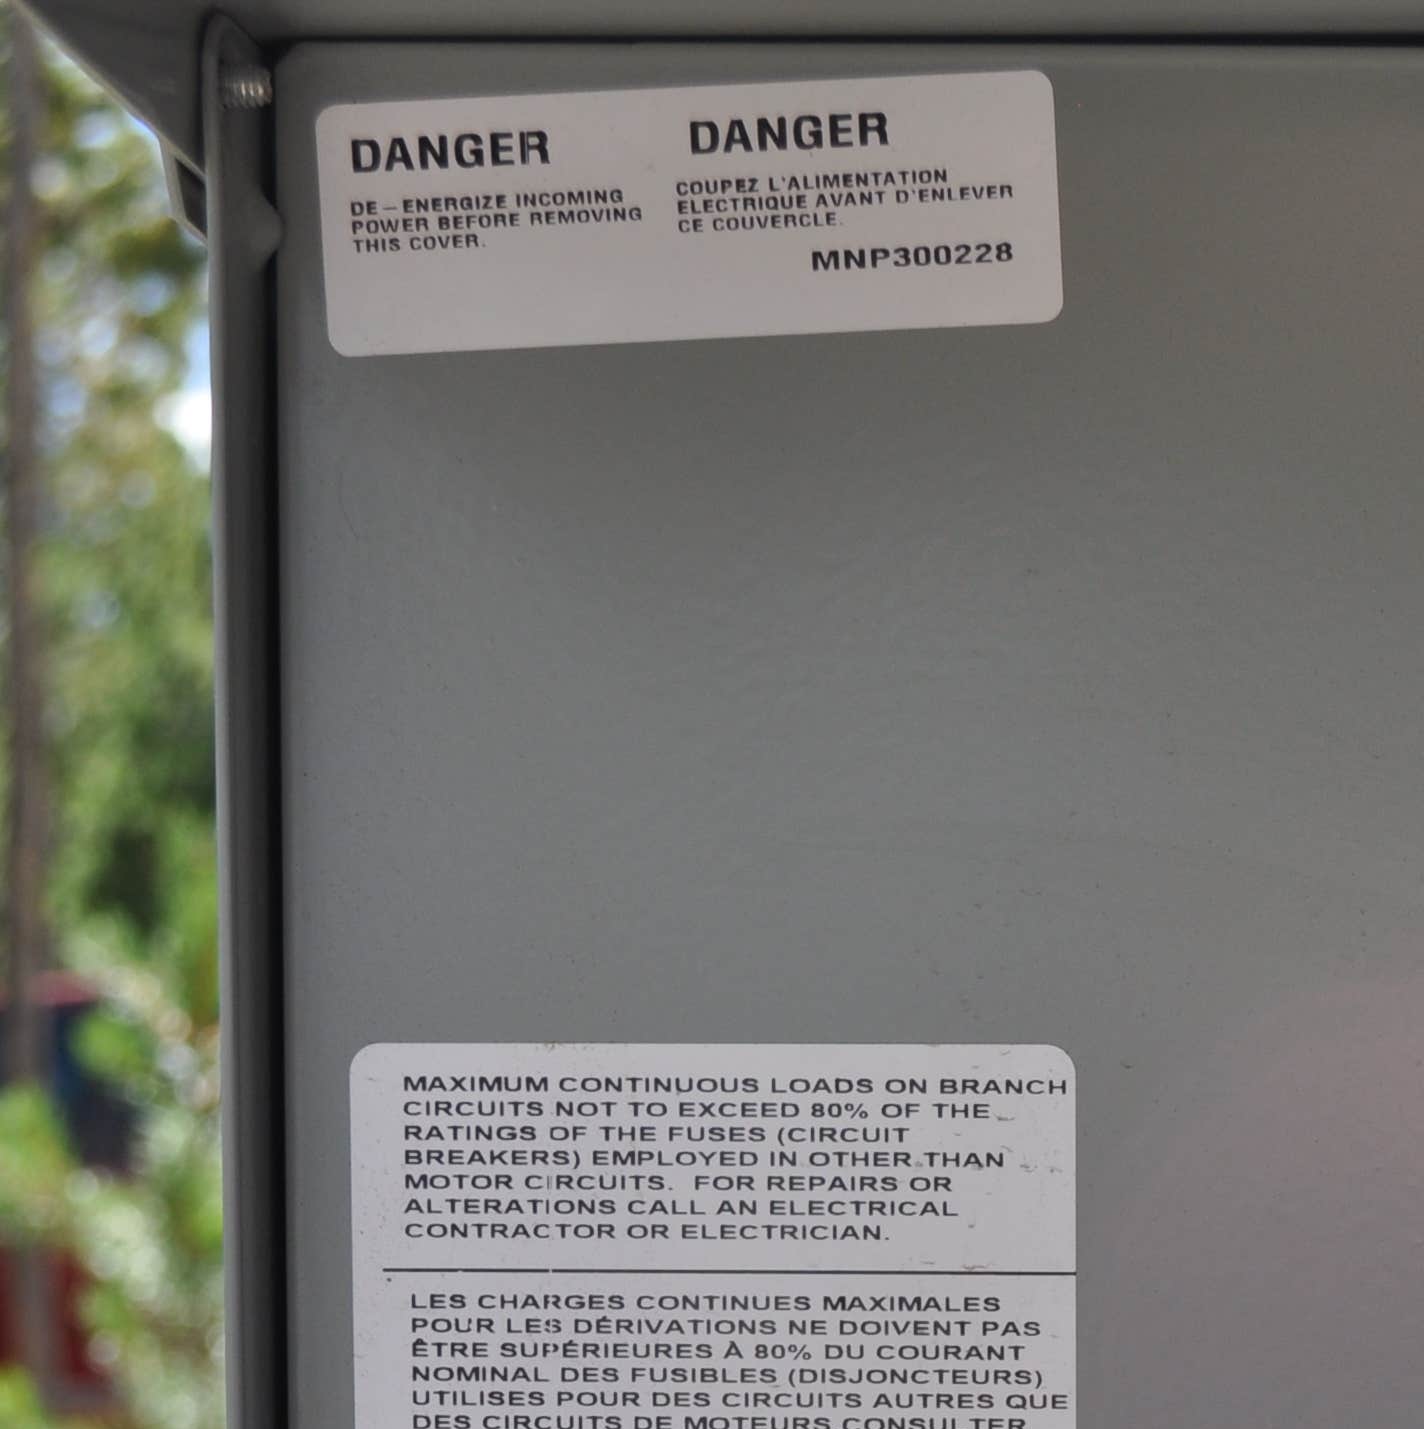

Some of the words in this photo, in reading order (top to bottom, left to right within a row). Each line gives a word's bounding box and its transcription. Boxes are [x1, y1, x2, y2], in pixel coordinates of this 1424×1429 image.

[689, 111, 889, 155] DANGER
[350, 130, 551, 174] DANGER
[675, 177, 759, 197] COUPEZ
[768, 168, 948, 193] L'ALIMENTATION
[676, 194, 807, 215] ELECTRIQUE
[815, 190, 886, 208] AVANT
[895, 184, 1013, 204] D'ENLEVER
[351, 216, 429, 236] POWER
[437, 212, 520, 231] BEFORE
[529, 206, 642, 226] REMOVING
[677, 218, 703, 233] CE
[712, 211, 844, 232] COUVERCLE.
[352, 237, 401, 254] THIS
[409, 233, 487, 251] COVER.
[811, 241, 1013, 272] MNP300228
[403, 1075, 549, 1093] MAXIMUM
[558, 1076, 759, 1094] CONTINUOUS
[771, 1077, 874, 1094] LOADS
[884, 1078, 927, 1095] ON
[939, 1078, 1067, 1095] BRANCH
[403, 1100, 544, 1117] CIRCUITS
[555, 1100, 618, 1118] NOT
[627, 1101, 668, 1118] TO
[678, 1101, 800, 1118] EXCEED
[810, 1102, 869, 1119] 80%
[880, 1102, 921, 1119] OF
[932, 1102, 990, 1119] THE
[404, 1124, 537, 1142] RATINGS
[549, 1125, 587, 1142] OF
[599, 1125, 657, 1142] THE
[668, 1126, 766, 1143] FUSES
[777, 1126, 910, 1147] (CIRCUIT
[404, 1149, 581, 1170] BREAKERS)
[592, 1149, 759, 1167] EMPLOYED
[769, 1150, 797, 1167] IN
[808, 1151, 912, 1168] OTHER
[923, 1151, 1004, 1169] THAN
[404, 1173, 514, 1190] MOTOR
[524, 1174, 673, 1191] CIRCUITS.
[694, 1175, 755, 1191] FOR
[766, 1175, 898, 1192] REPAIRS
[909, 1175, 953, 1192] OR
[403, 1198, 617, 1215] ALTERATIONS
[627, 1199, 706, 1216] CALL
[715, 1199, 757, 1216] AN
[769, 1199, 959, 1217] ELECTRICAL
[404, 1222, 616, 1239] CONTRACTOR
[626, 1223, 670, 1240] OR
[681, 1223, 890, 1241] ELECTRICIAN.
[411, 1293, 467, 1310] LES
[477, 1293, 625, 1310] CHARGES
[636, 1294, 812, 1311] CONTINUES
[823, 1295, 1001, 1313] MAXIMALES
[411, 1317, 495, 1334] POUR
[506, 1317, 562, 1334] LES
[573, 1315, 777, 1335] DÉRIVATIONS
[788, 1319, 828, 1336] NE
[839, 1319, 972, 1337] DOIVENT
[982, 1320, 1041, 1337] PAS
[411, 1337, 489, 1358] ÊTRE
[499, 1339, 713, 1359] SUPÉRIEURES
[723, 1340, 744, 1360] À
[754, 1343, 812, 1361] 80%
[824, 1343, 865, 1360] DU
[876, 1344, 1026, 1361] COURANT
[411, 1365, 550, 1383] NOMINAL
[560, 1366, 620, 1383] DES
[631, 1367, 777, 1384] FUSIBLES
[788, 1367, 1043, 1390] (DISJONCTEURS)
